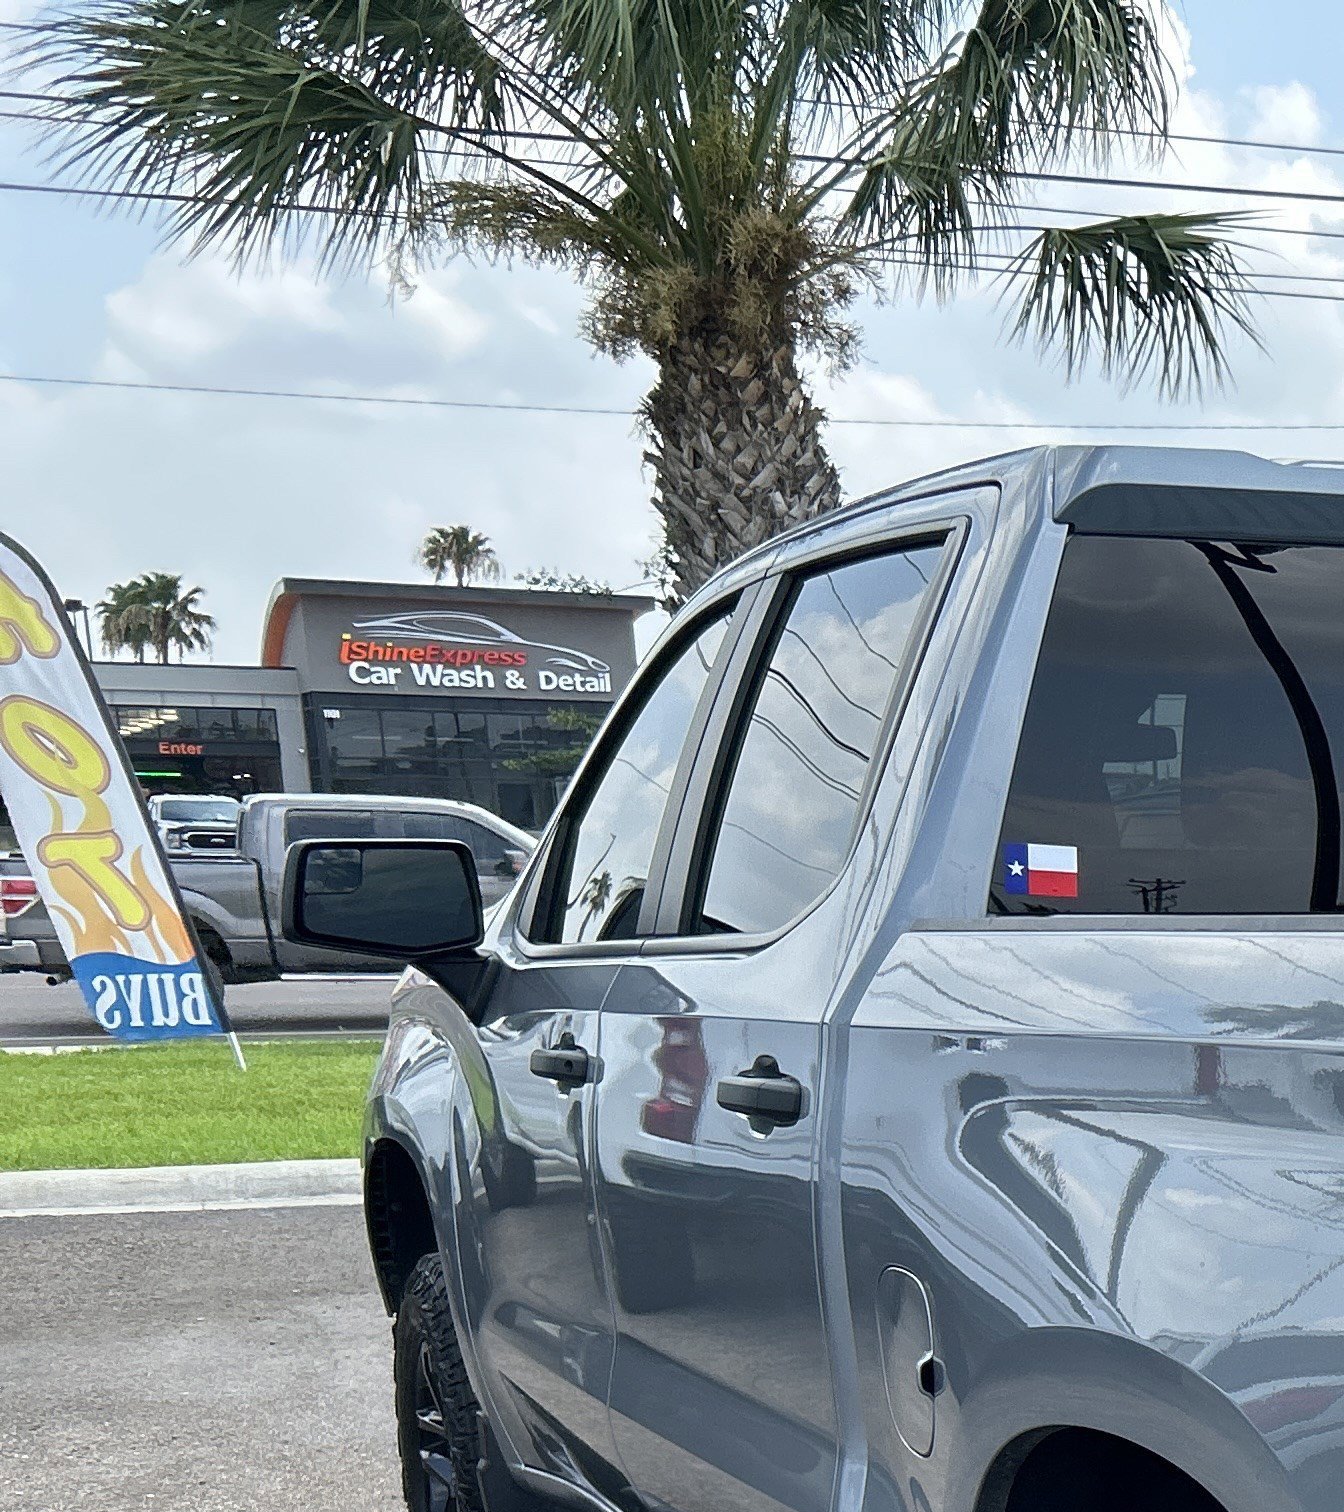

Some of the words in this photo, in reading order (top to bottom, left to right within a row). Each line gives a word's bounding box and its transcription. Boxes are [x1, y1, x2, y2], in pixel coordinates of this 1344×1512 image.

[339, 633, 527, 666] iShineExpress
[349, 661, 401, 685] Car
[410, 663, 494, 688] Wash
[505, 670, 527, 690] &
[538, 670, 611, 693] Detail
[158, 742, 204, 755] Enter
